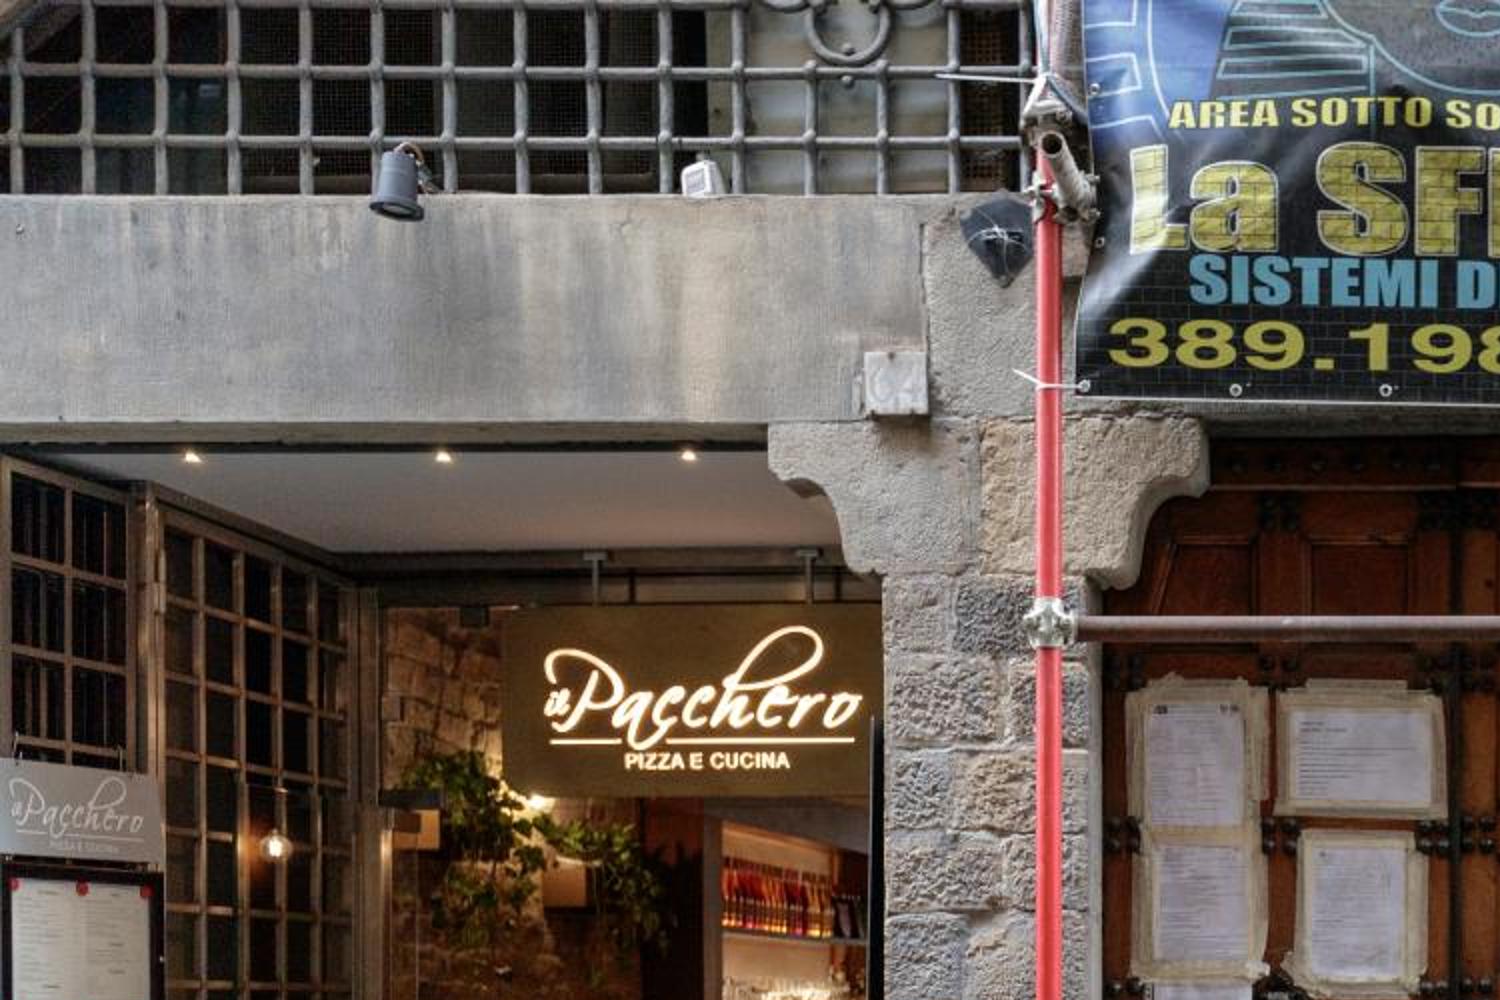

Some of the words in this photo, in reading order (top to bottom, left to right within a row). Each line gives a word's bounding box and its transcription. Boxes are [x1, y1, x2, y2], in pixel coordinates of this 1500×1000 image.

[1169, 99, 1279, 128] AREA
[1291, 97, 1432, 128] SOTTO
[1127, 144, 1281, 256] La
[1189, 255, 1437, 309] SISTEMI
[544, 625, 863, 750] Pacchero
[624, 751, 684, 771] PIZZA
[689, 751, 704, 770] E
[708, 750, 791, 770] CUCINA
[8, 776, 146, 839] Pacchero
